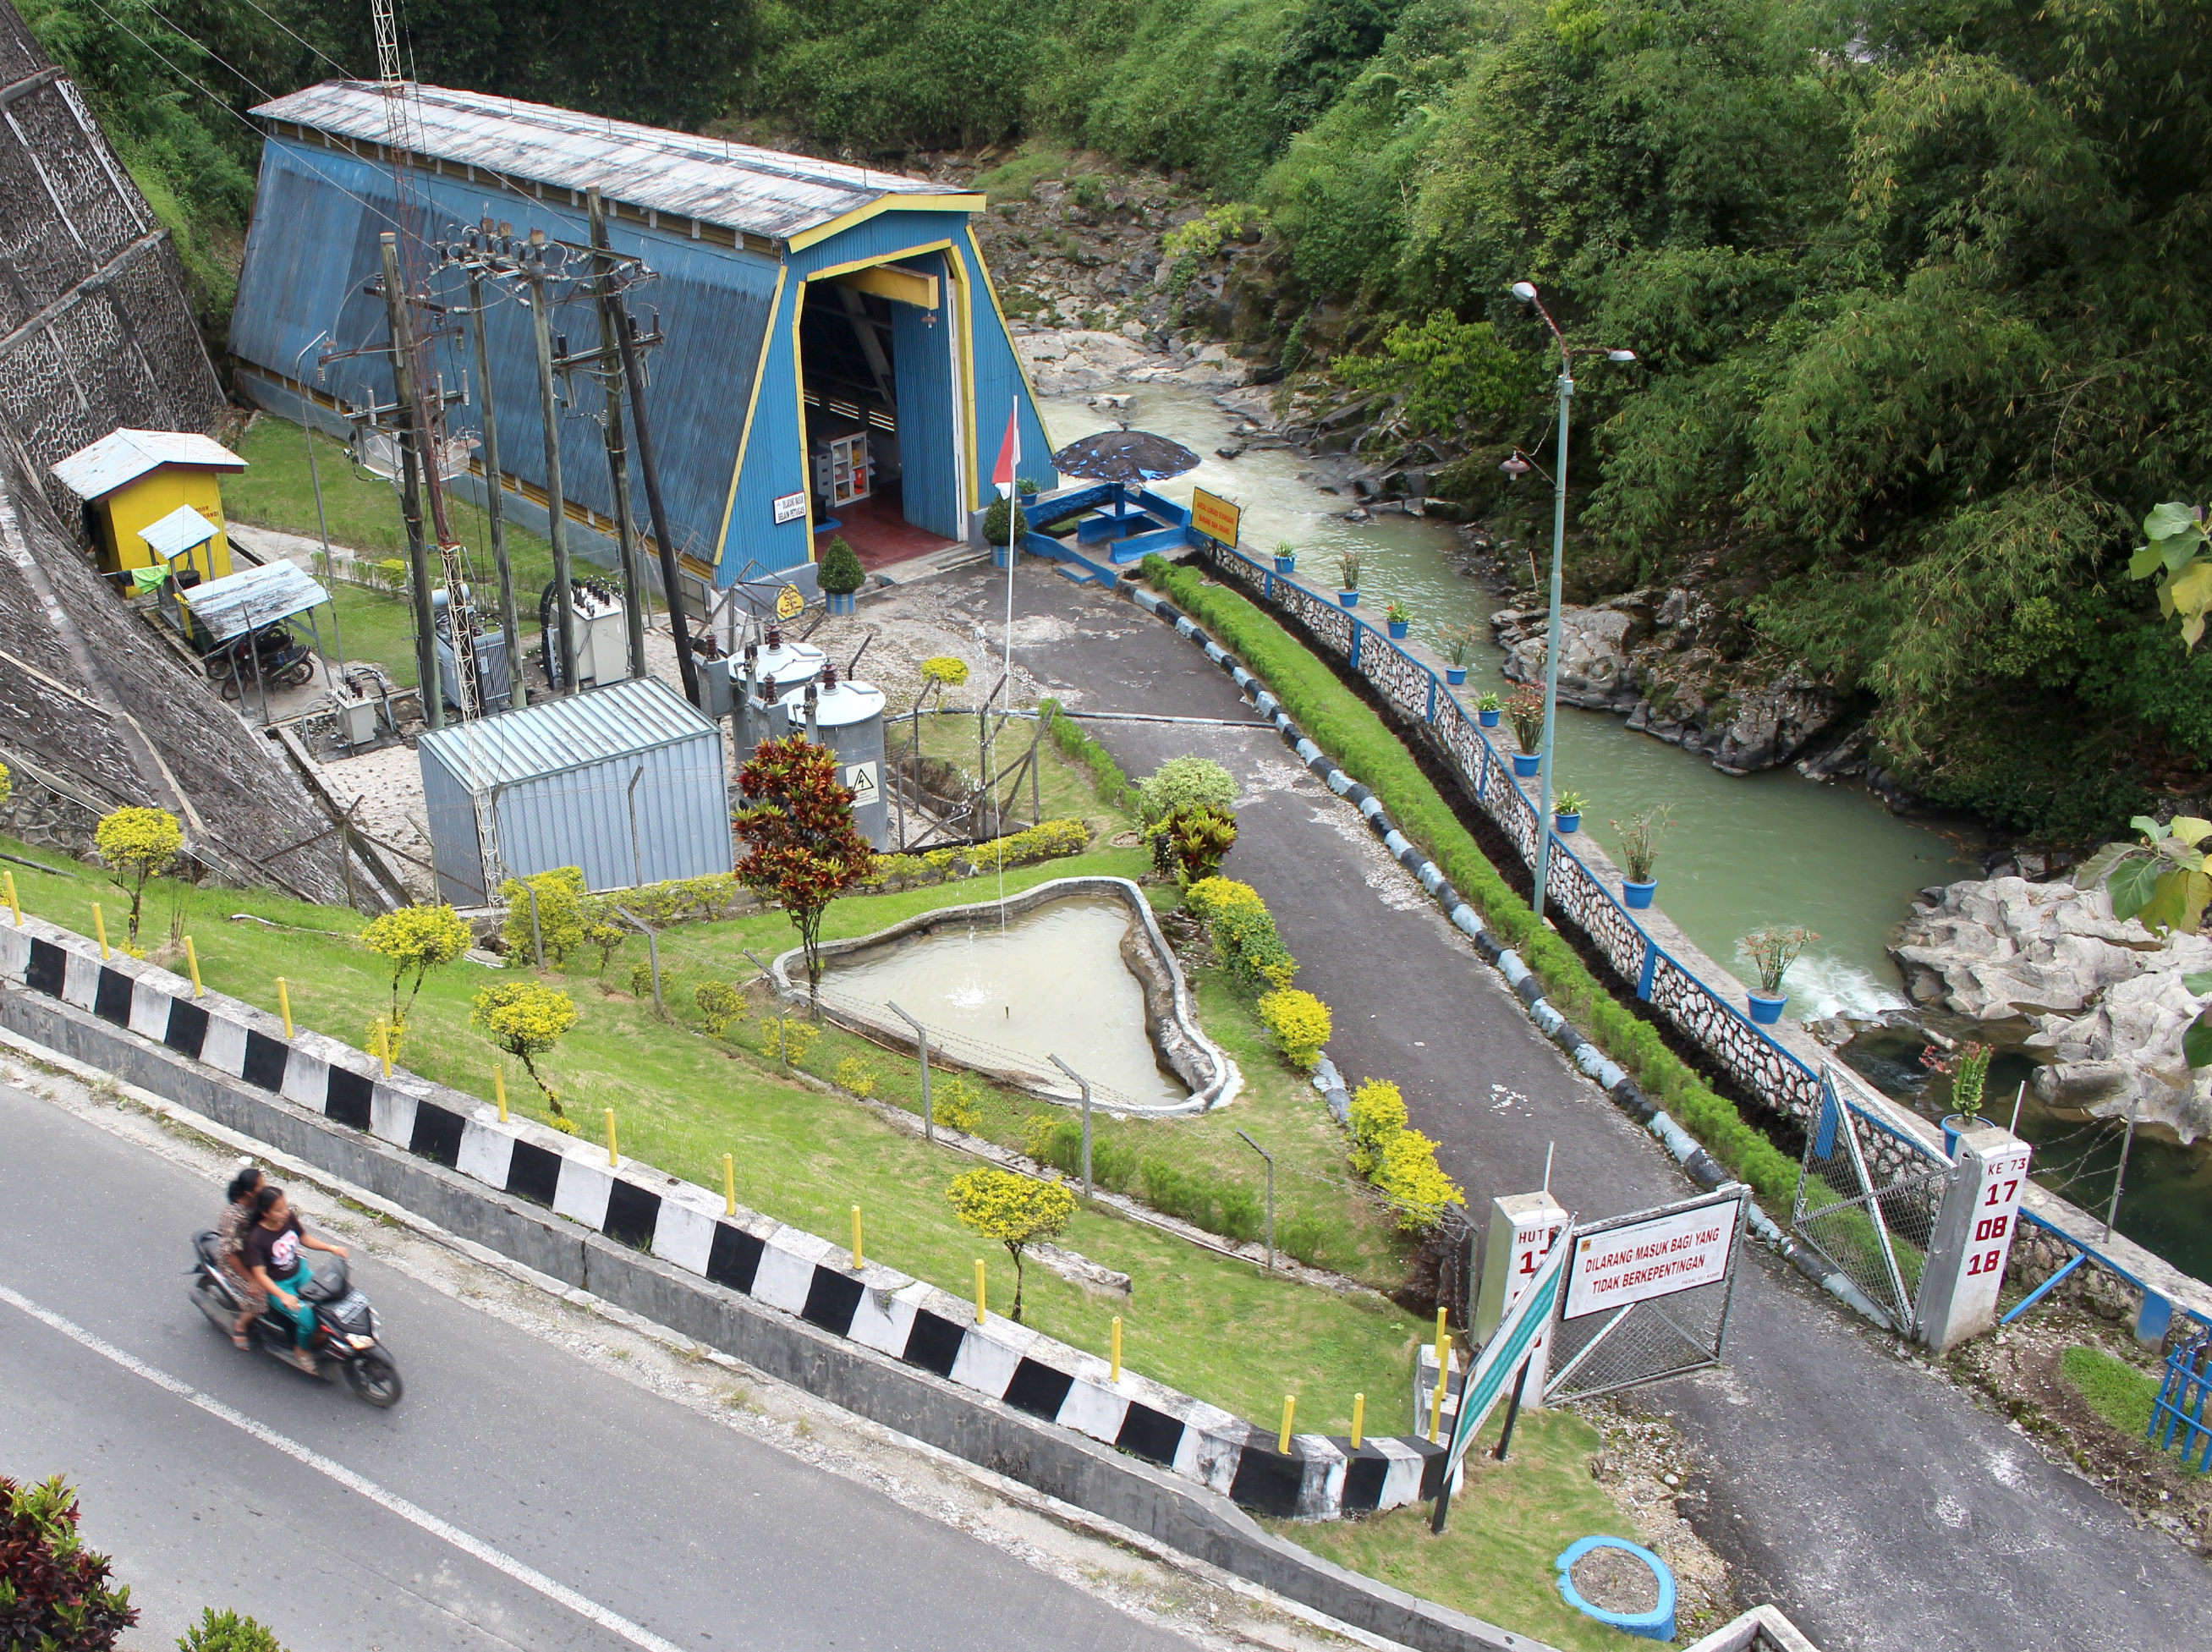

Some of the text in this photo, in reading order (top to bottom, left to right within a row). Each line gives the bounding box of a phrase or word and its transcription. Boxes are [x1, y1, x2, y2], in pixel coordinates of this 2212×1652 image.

[1988, 1158, 2027, 1176] KE 73
[1984, 1180, 2018, 1206] 17
[1518, 1229, 1545, 1243] HUT
[1975, 1216, 2008, 1242] 08
[1585, 1228, 1720, 1273] DILARANG MASUK BAGI YANG
[1967, 1249, 2001, 1276] 18
[1593, 1254, 1705, 1294] TIDAK BERKEPENTINGAN
